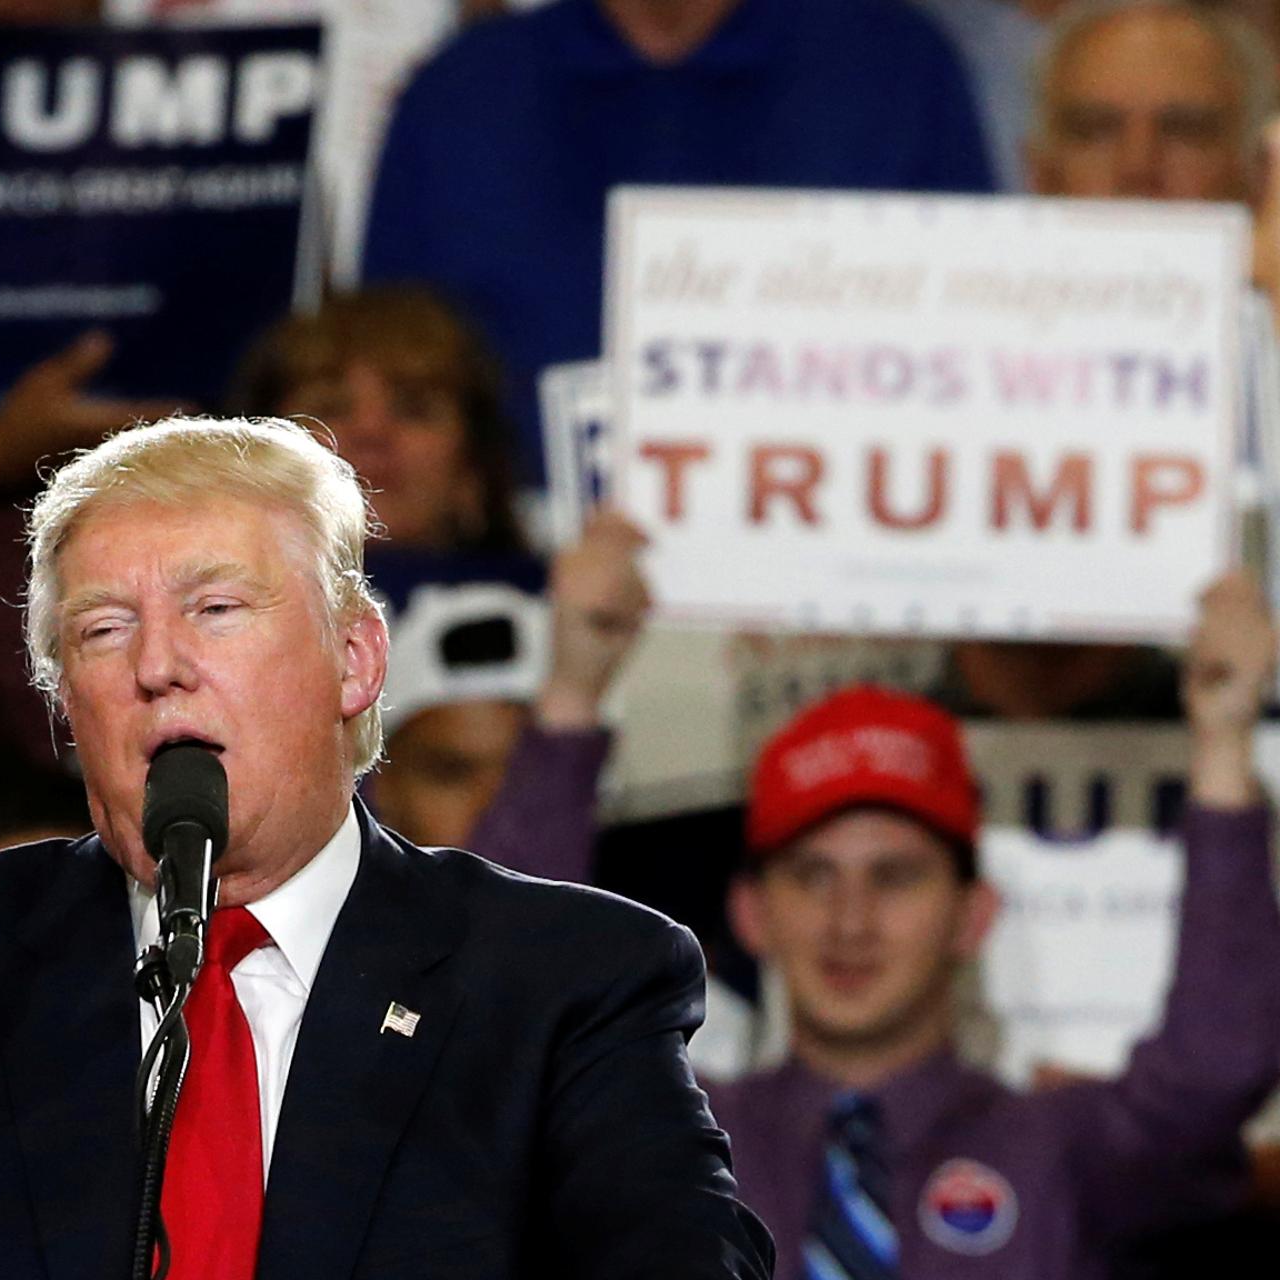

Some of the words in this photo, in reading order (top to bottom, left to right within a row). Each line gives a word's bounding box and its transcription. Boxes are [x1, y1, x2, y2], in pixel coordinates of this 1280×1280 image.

[941, 255, 1212, 338] majority
[639, 337, 970, 406] STANDS
[992, 348, 1210, 412] WITH
[636, 436, 1210, 538] TRUMP
